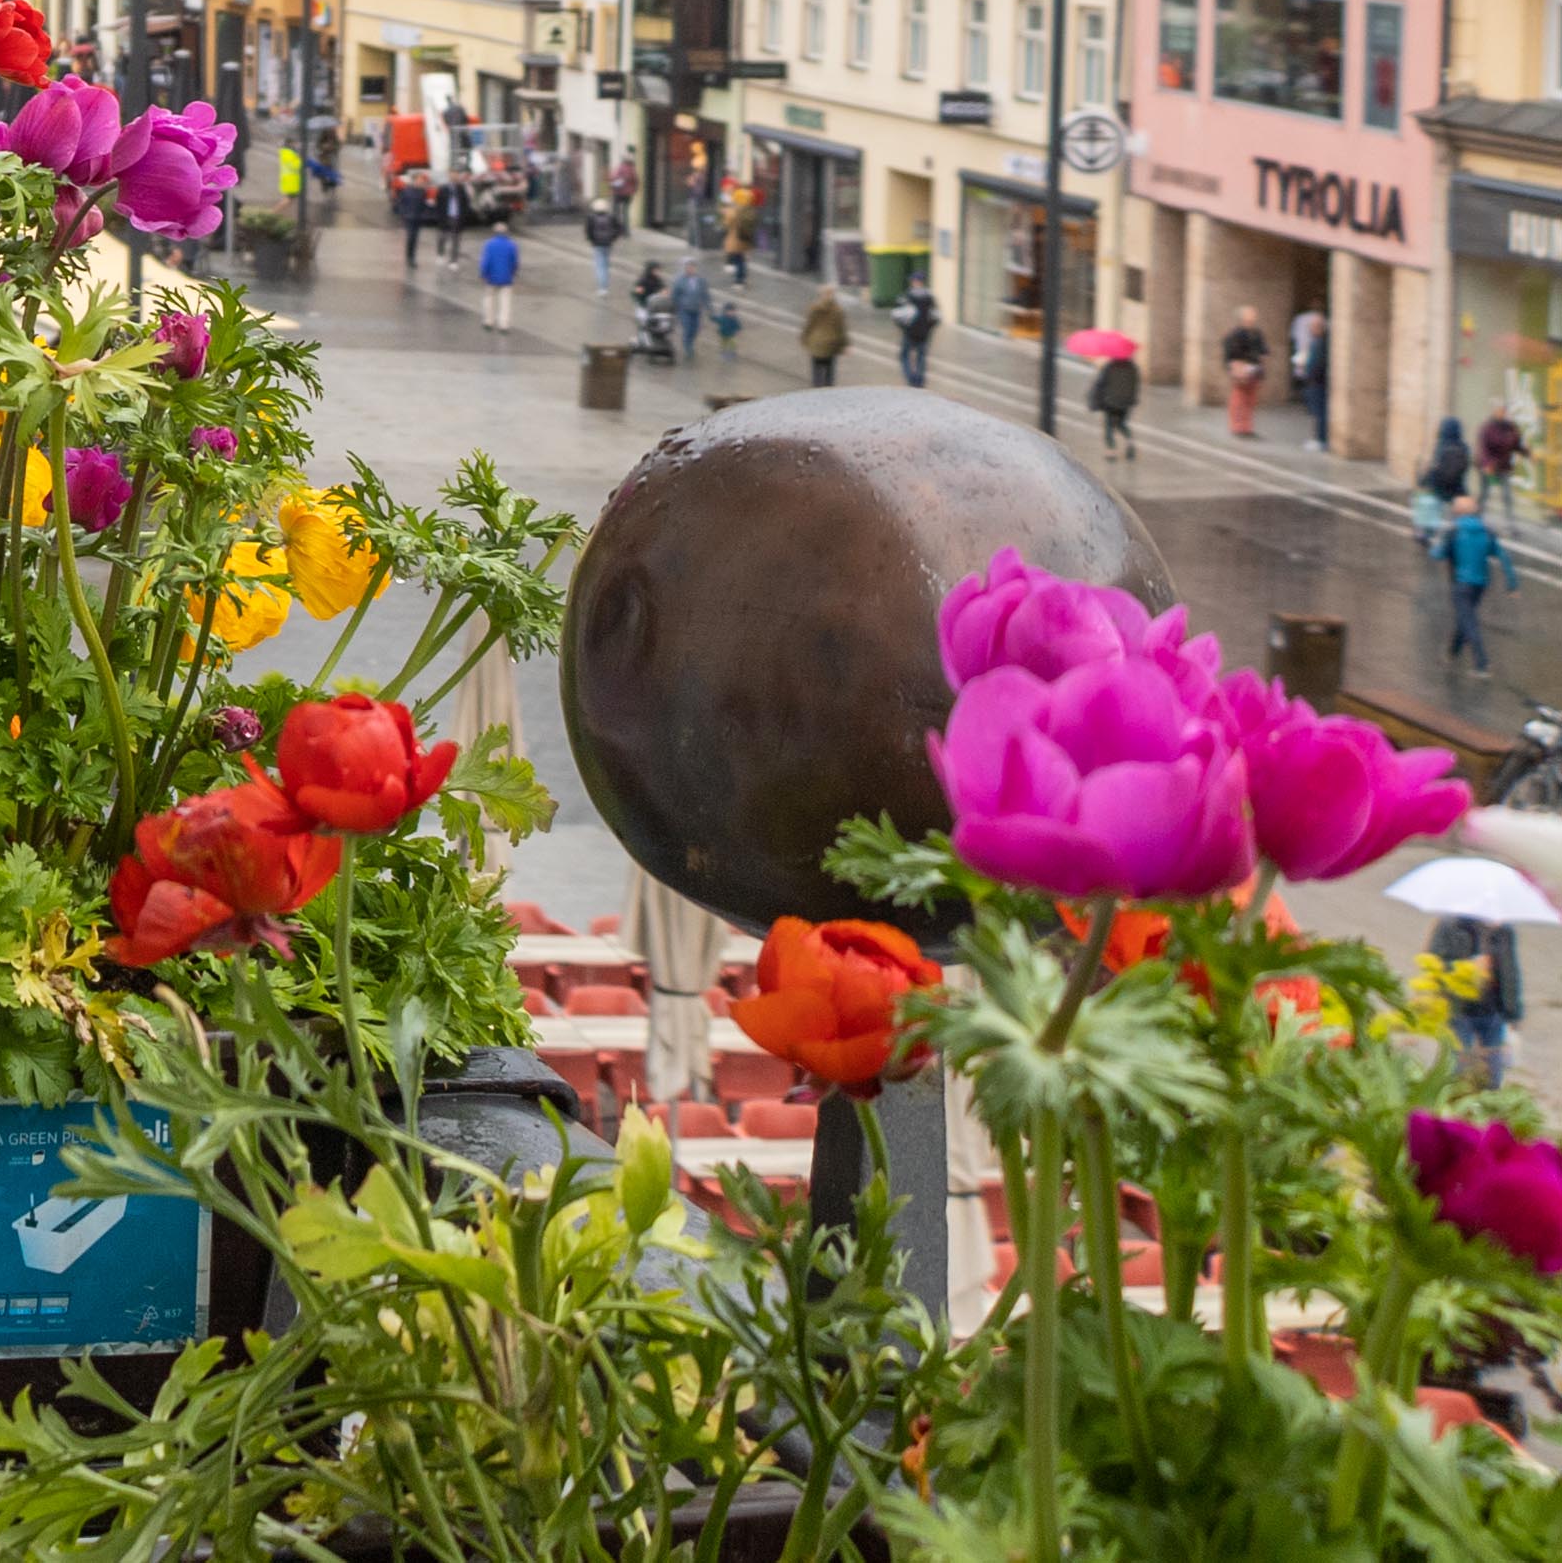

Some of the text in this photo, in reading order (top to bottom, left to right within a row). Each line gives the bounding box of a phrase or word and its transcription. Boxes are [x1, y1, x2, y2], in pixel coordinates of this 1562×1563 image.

[1252, 156, 1405, 244] TYROLIA
[8, 1132, 57, 1146] GREEN
[62, 1130, 89, 1144] PLU
